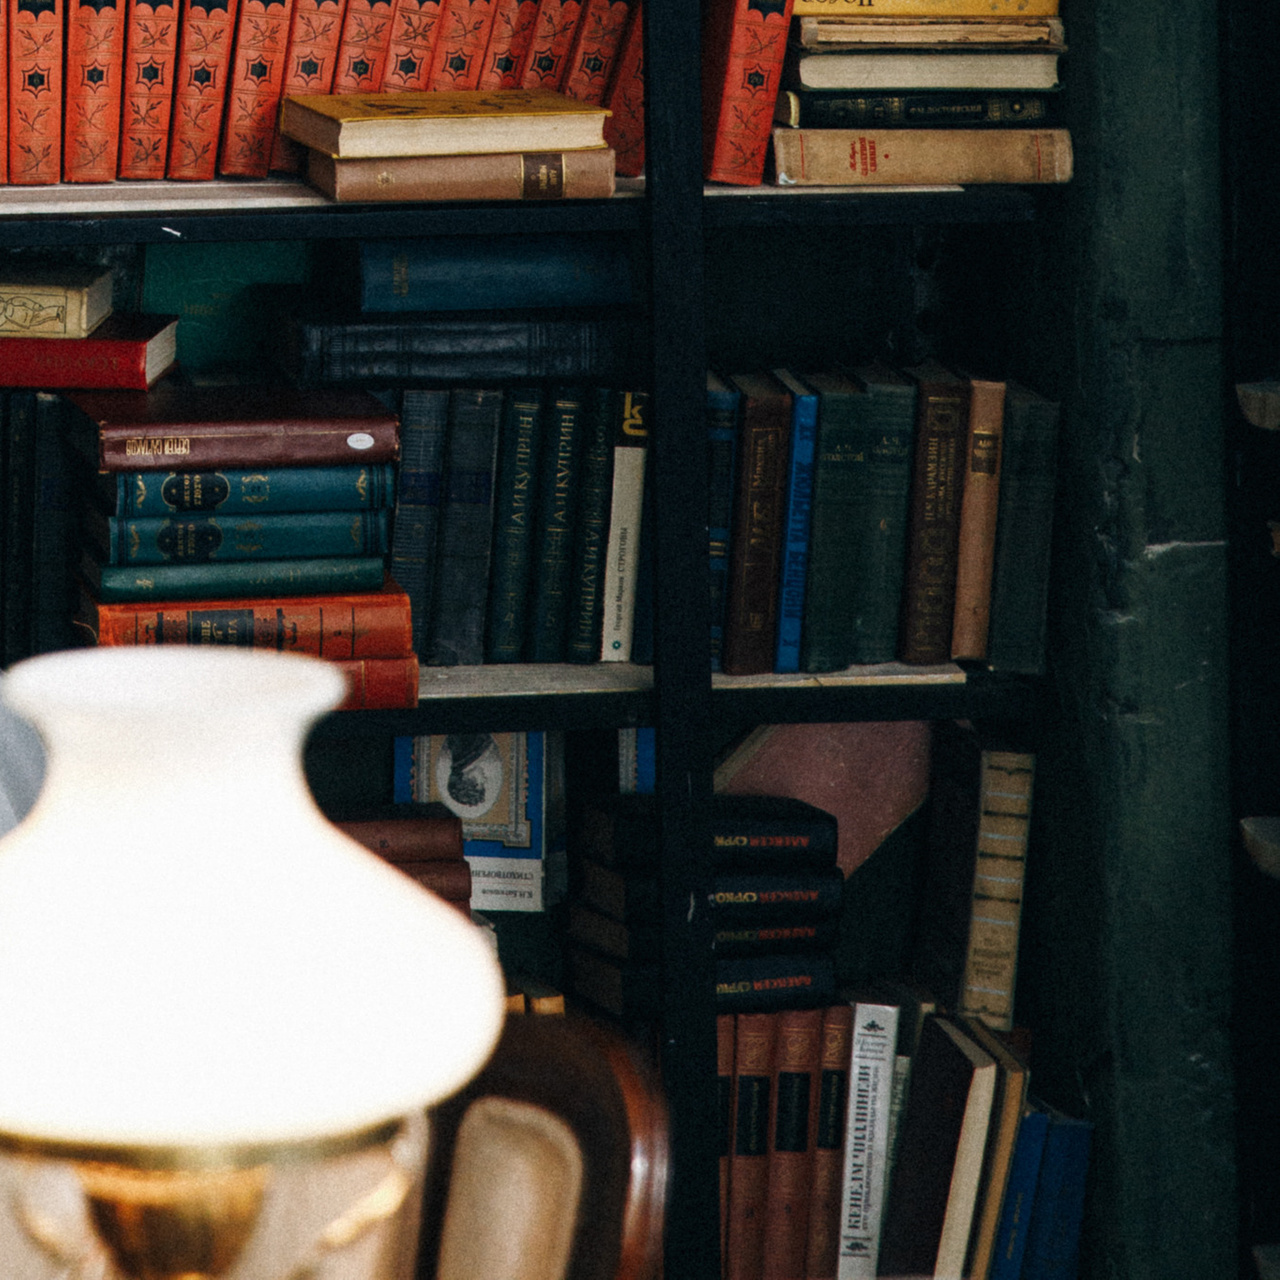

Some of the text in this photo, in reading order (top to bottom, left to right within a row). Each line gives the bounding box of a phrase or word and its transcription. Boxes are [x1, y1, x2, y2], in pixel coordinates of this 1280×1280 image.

[515, 415, 533, 490] КУПРИН
[556, 414, 574, 489] КУПРИН
[617, 526, 628, 573] СТРОГОВЫ
